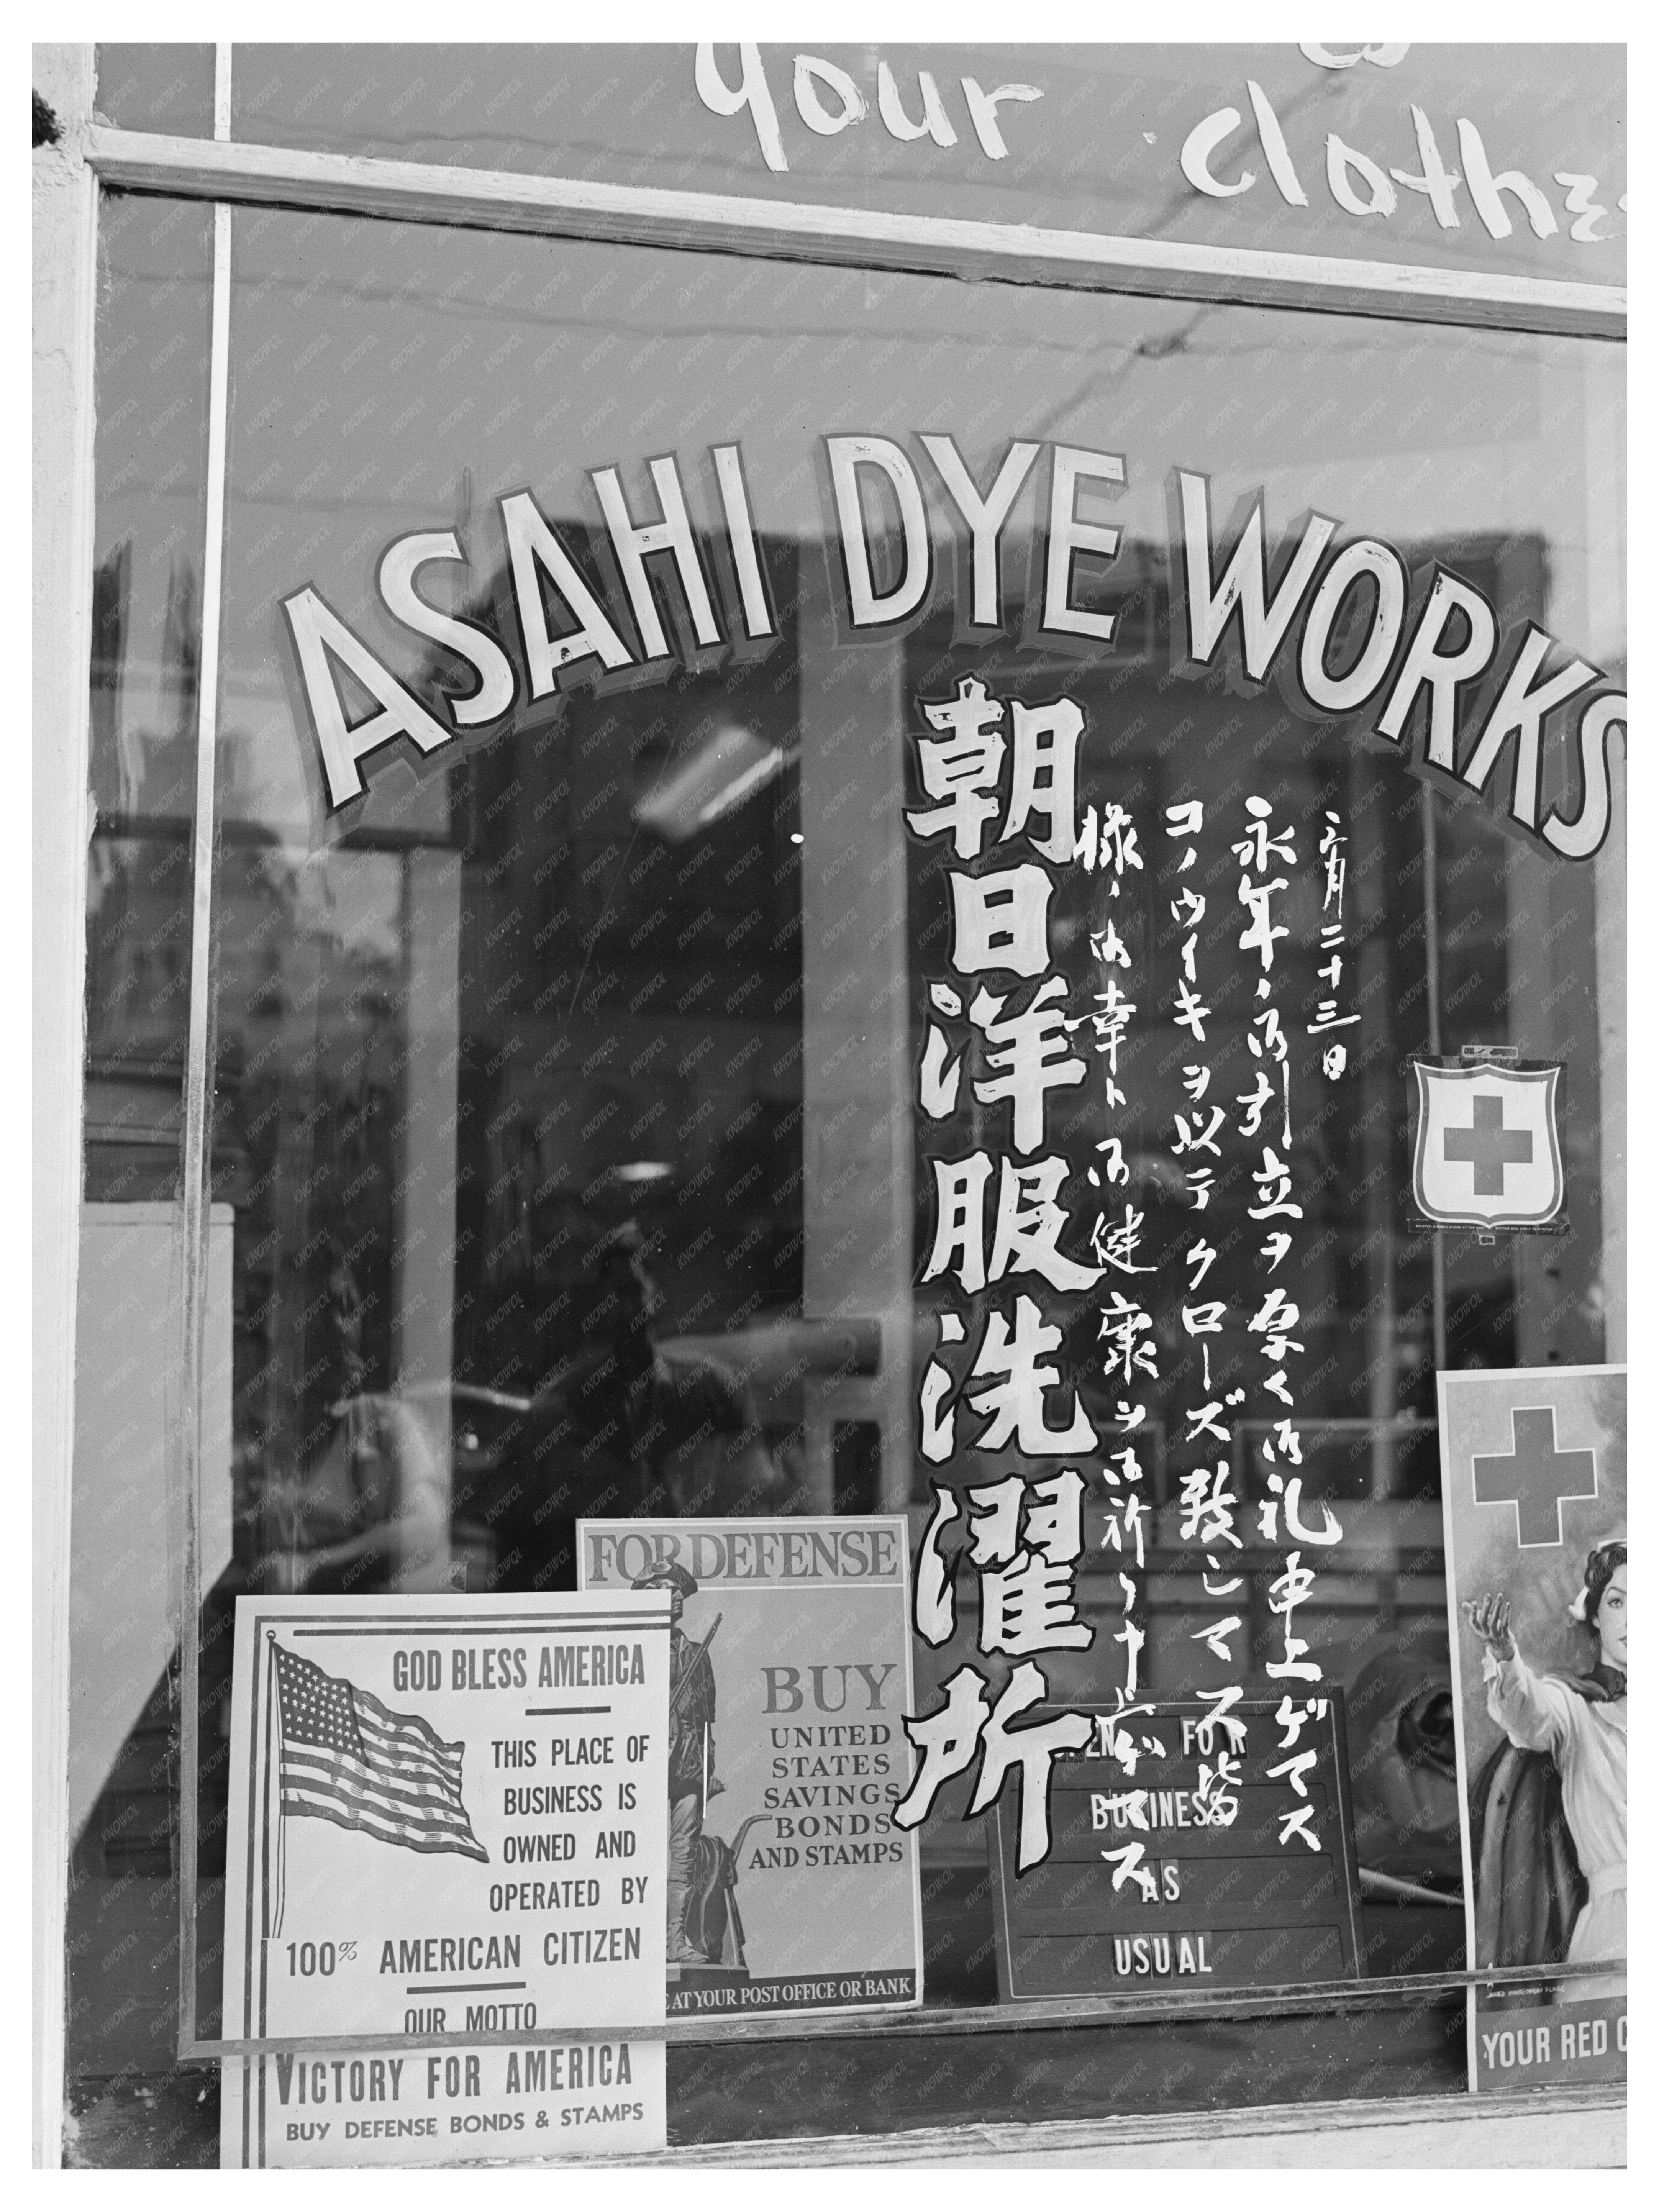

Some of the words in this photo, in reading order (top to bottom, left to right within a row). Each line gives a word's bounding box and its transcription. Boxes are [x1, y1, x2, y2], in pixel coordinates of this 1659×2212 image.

[694, 42, 1044, 172] your
[1179, 79, 1627, 244] clothe
[280, 443, 774, 812] ASAHI
[824, 433, 1126, 641] DYE
[1175, 469, 1627, 859] WORKS
[892, 674, 1107, 1878] 朝日洋服洗濯所
[588, 1533, 681, 1581] FOR
[687, 1530, 898, 1579] DEFENSE
[393, 1650, 442, 1691] GOD
[452, 1647, 527, 1690] BLESS
[538, 1644, 646, 1688] AMERICA
[760, 1664, 897, 1714] BUY
[491, 1740, 537, 1768] THIS
[551, 1736, 614, 1766] PLACE
[626, 1735, 650, 1763] OF
[770, 1724, 890, 1748] UNITED
[772, 1753, 890, 1778] STATES
[504, 1784, 603, 1815] BUSINESS
[618, 1782, 637, 1810] IS
[764, 1783, 901, 1809] SAVINGS
[775, 1813, 891, 1838] BONDS
[503, 1833, 576, 1864] OWNED
[595, 1830, 636, 1859] AND
[748, 1846, 800, 1869] AND
[805, 1842, 903, 1866] STAMPS
[489, 1879, 600, 1912] OPERATED
[621, 1876, 648, 1905] BY
[286, 1941, 358, 1976] 100%
[379, 1935, 521, 1974] AMERICAN
[544, 1927, 641, 1966] CITIZEN
[1114, 1936, 1213, 1974] USUAL
[672, 1992, 692, 2009] AT
[693, 1988, 738, 2008] YOUR
[740, 1986, 780, 2004] POST
[782, 1982, 837, 2002] OFFICE
[839, 1980, 863, 1998] OR
[865, 1977, 911, 1997] BANK
[404, 2007, 446, 2033] OUR
[466, 2002, 537, 2031] MOTTO
[1482, 2027, 1551, 2069] YOUR
[1561, 2019, 1607, 2061] RED
[276, 2053, 404, 2105] VICTORY
[427, 2055, 481, 2099] FOR
[505, 2043, 632, 2094] AMERICA
[287, 2122, 331, 2141] BUY
[345, 2117, 438, 2139] DEFENSE
[450, 2112, 525, 2134] BONDS
[534, 2110, 550, 2128] &
[560, 2102, 643, 2126] STAMPS
